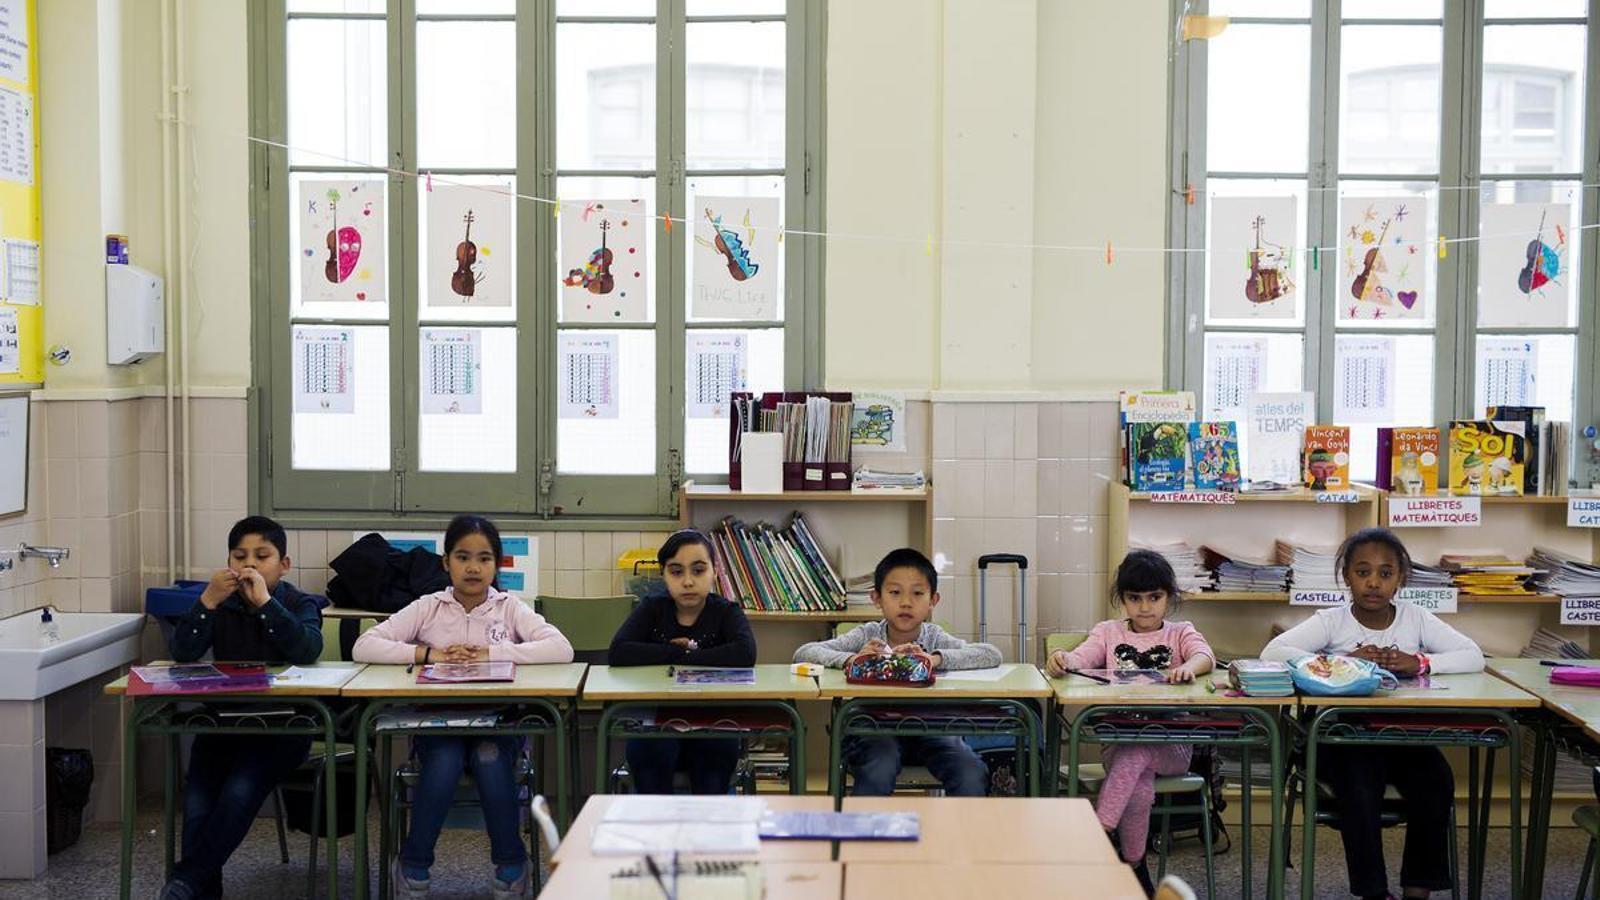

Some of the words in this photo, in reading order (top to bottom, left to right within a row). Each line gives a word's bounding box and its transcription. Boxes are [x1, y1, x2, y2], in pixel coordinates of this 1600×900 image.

[1256, 417, 1304, 432] TEMPS
[1396, 431, 1436, 440] Leonardo
[1400, 441, 1411, 451] da
[1415, 441, 1438, 451] Vinci
[1407, 500, 1462, 510] LLIBRETES
[1392, 511, 1479, 523] MATEMÀTIQUES
[1294, 591, 1346, 602] CASTELLÀ
[1398, 590, 1453, 600] LLIBRETES
[1565, 600, 1600, 609] LLIBRE
[1567, 611, 1600, 621] CASTE
